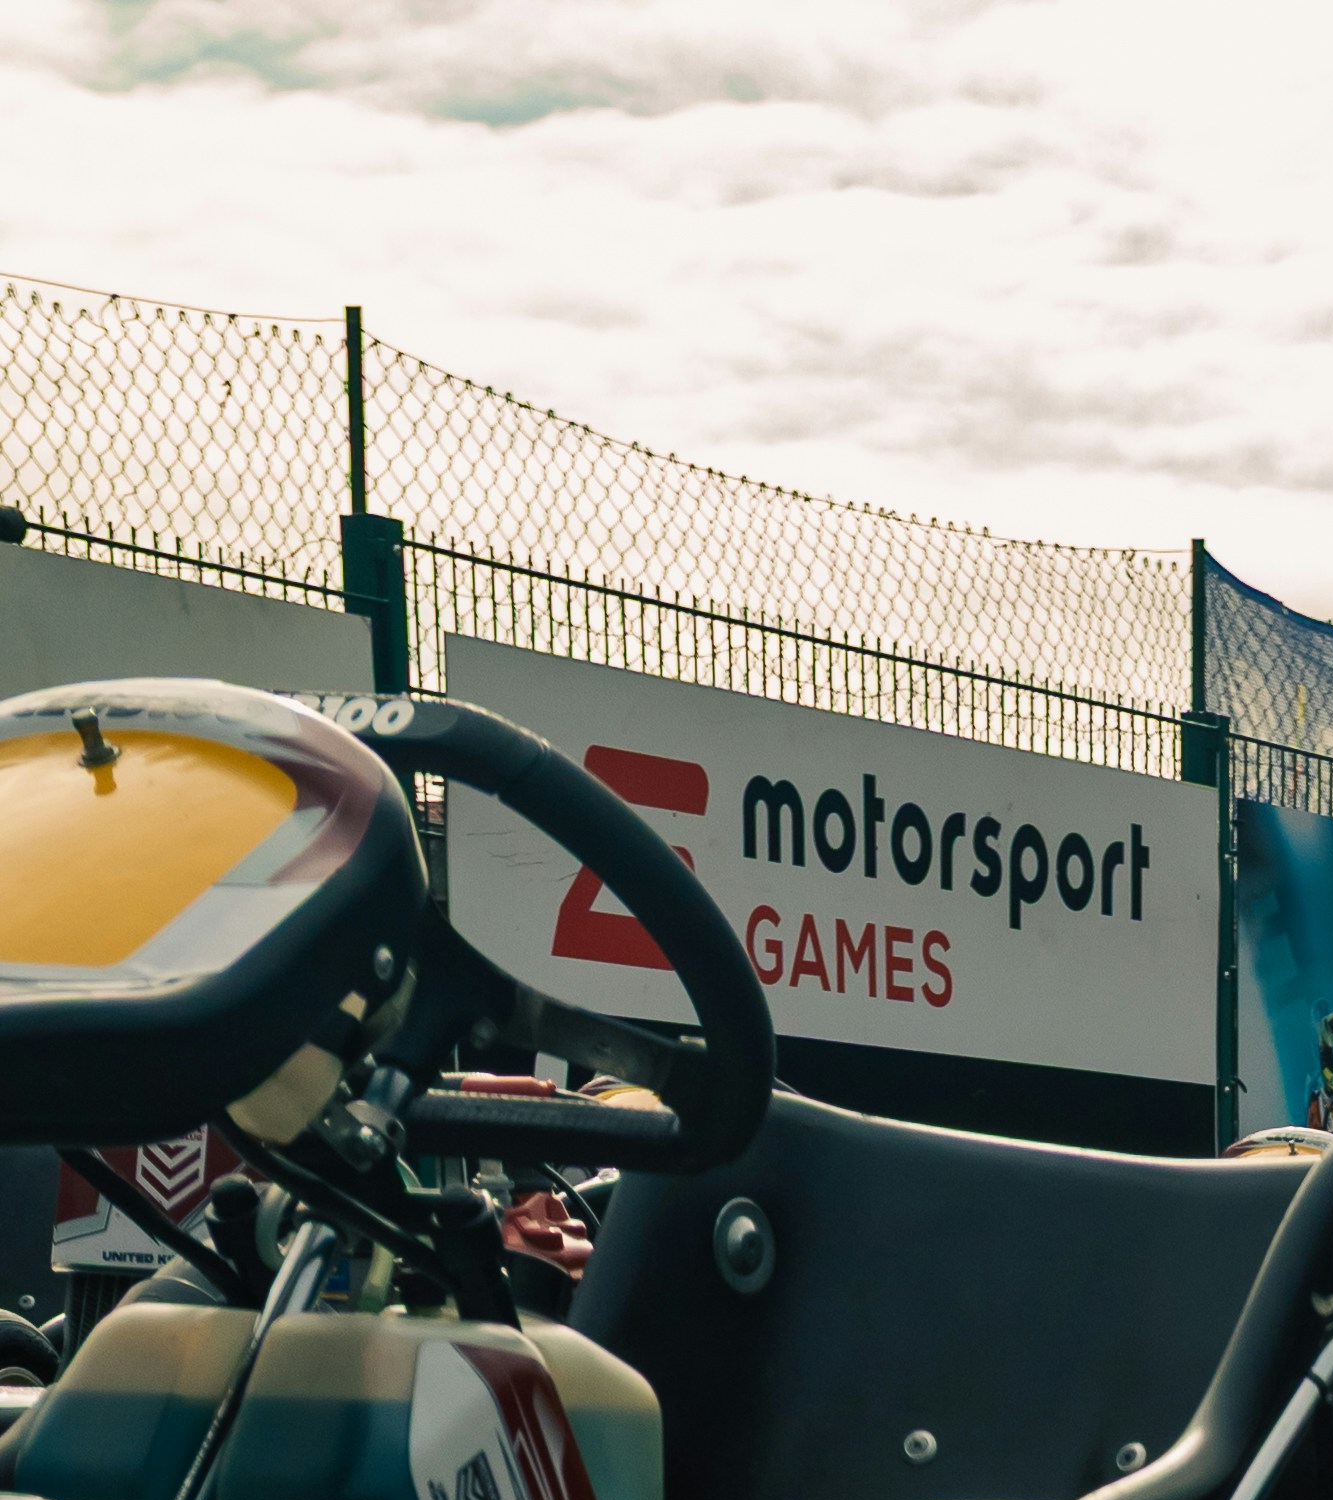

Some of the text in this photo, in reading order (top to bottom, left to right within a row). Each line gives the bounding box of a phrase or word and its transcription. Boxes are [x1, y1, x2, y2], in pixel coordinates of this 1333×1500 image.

[742, 772, 1150, 931] motorsport
[745, 904, 953, 1008] GAMES
[102, 1250, 155, 1264] UNITED
